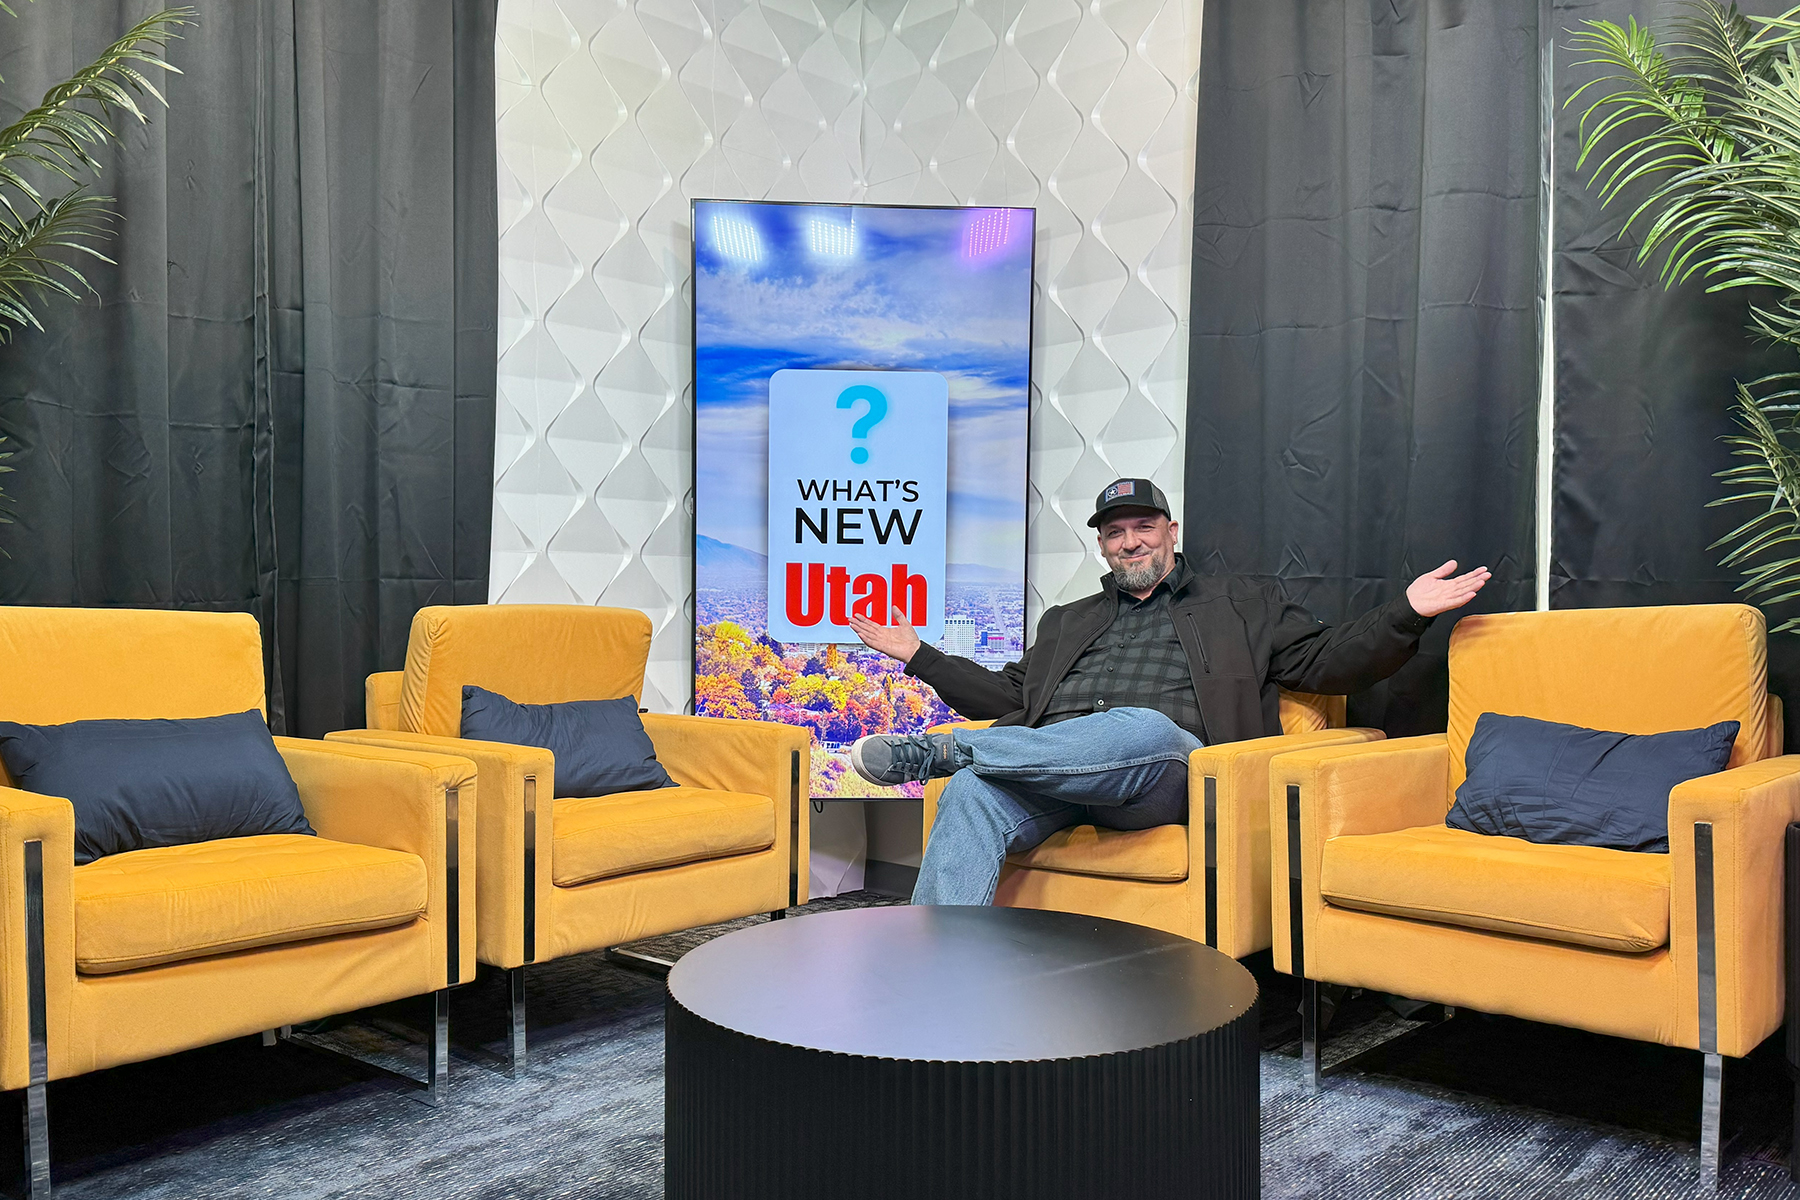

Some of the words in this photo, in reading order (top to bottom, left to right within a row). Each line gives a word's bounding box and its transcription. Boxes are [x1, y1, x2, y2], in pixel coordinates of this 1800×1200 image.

[796, 478, 919, 502] WHAT'S
[795, 507, 923, 545] NEW
[785, 562, 928, 627] Utah
